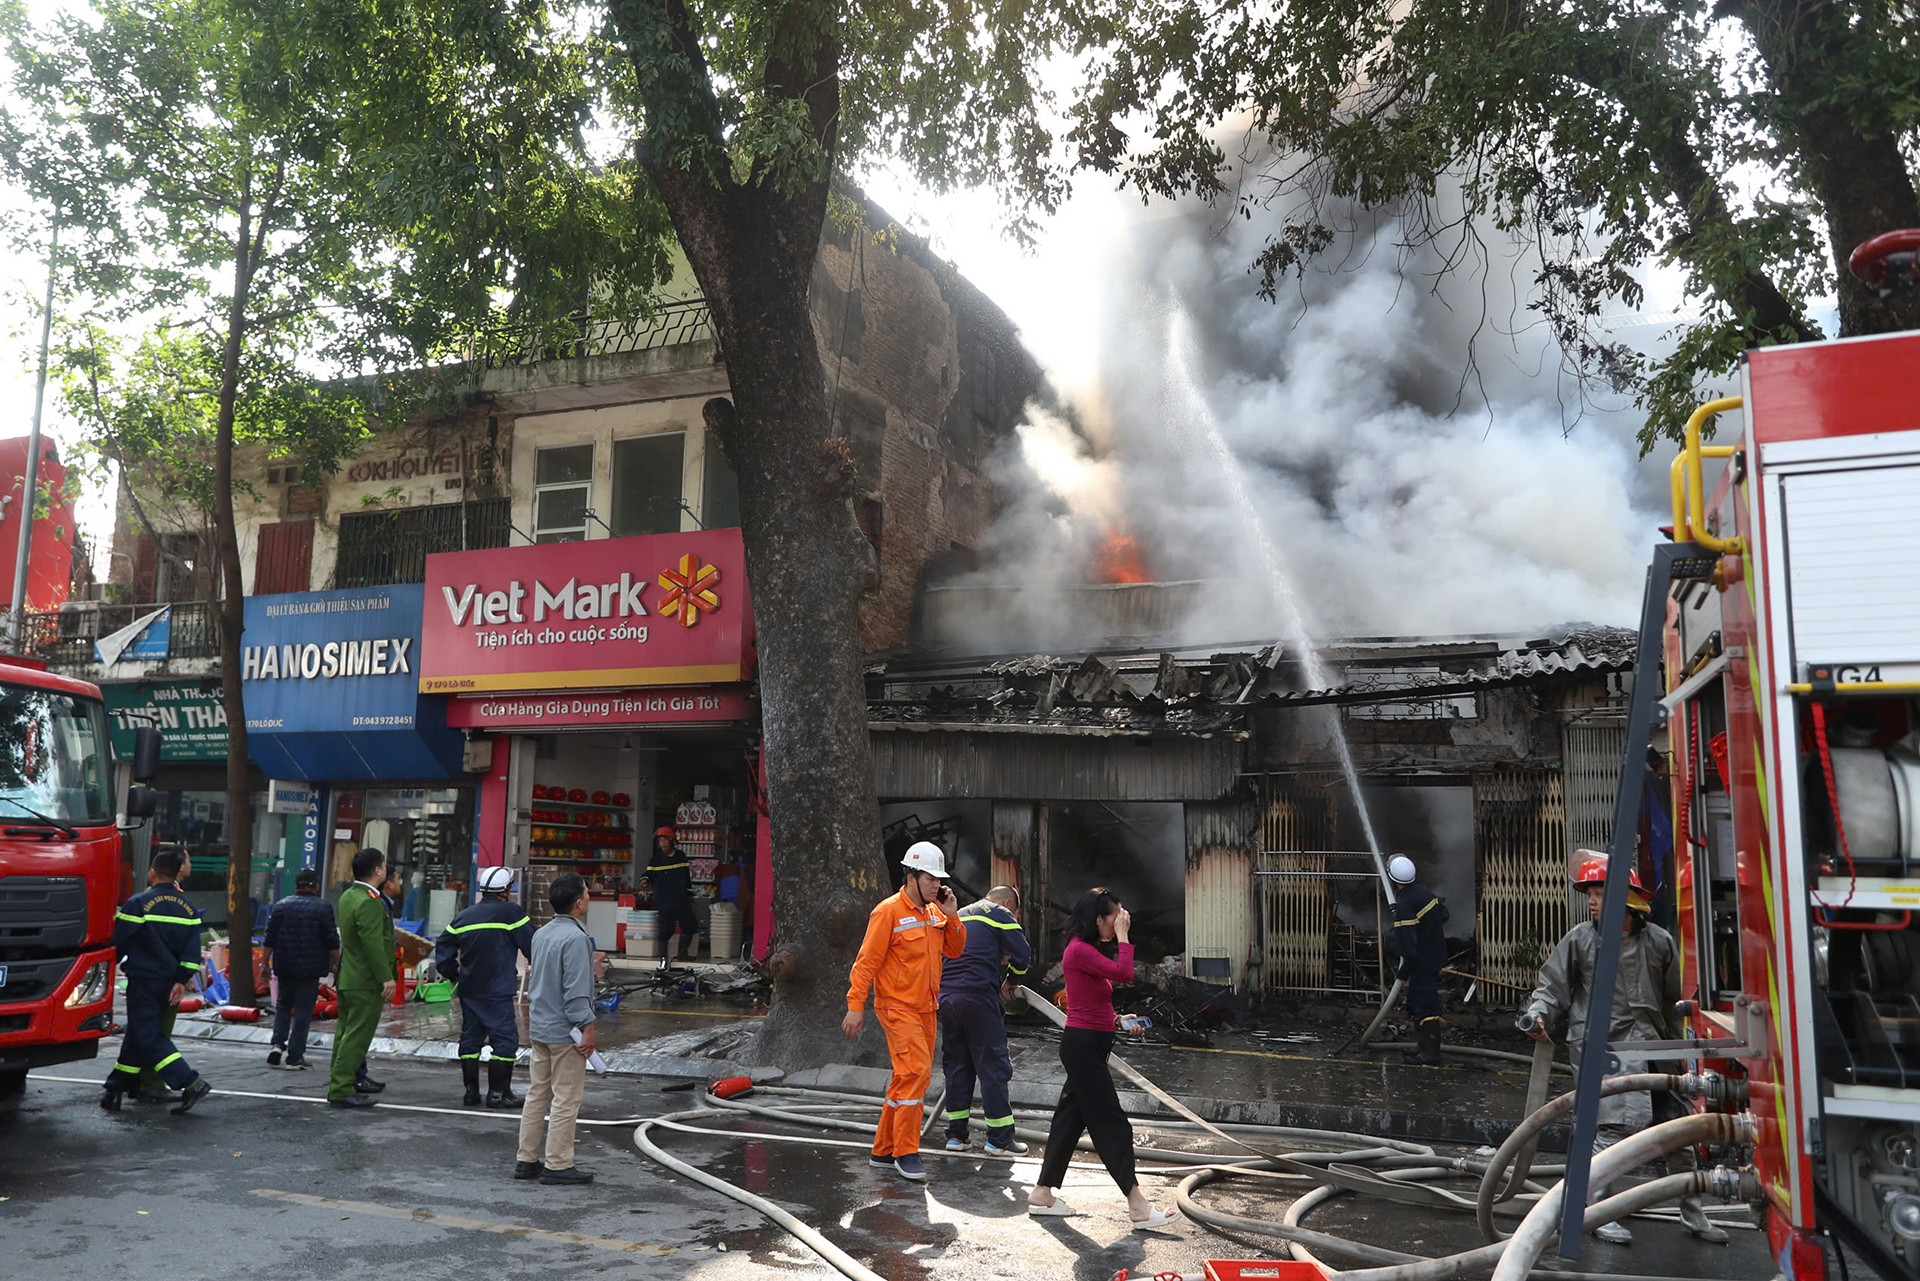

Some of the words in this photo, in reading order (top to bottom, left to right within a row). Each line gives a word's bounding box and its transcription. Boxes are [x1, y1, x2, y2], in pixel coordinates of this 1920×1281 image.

[326, 596, 351, 614] THIỆU
[442, 580, 527, 627] Viet
[533, 572, 648, 623] Mark
[475, 630, 508, 651] Tiện
[511, 628, 534, 646] ích
[537, 627, 566, 644] cho
[569, 624, 606, 646] cuộc
[609, 620, 649, 644] sống
[242, 637, 412, 680] HANOSIMEX
[1837, 664, 1883, 683] G4
[153, 686, 180, 701] NHÀ
[480, 700, 505, 717] Cửa
[508, 701, 544, 719] Hàng
[546, 700, 569, 715] Gia
[572, 700, 610, 718] Dụng
[612, 697, 642, 717] Tiện
[645, 694, 667, 712] Ích
[670, 695, 695, 711] Giá
[697, 692, 720, 709] Tốt
[380, 716, 394, 725] 972
[394, 715, 413, 725] 8451
